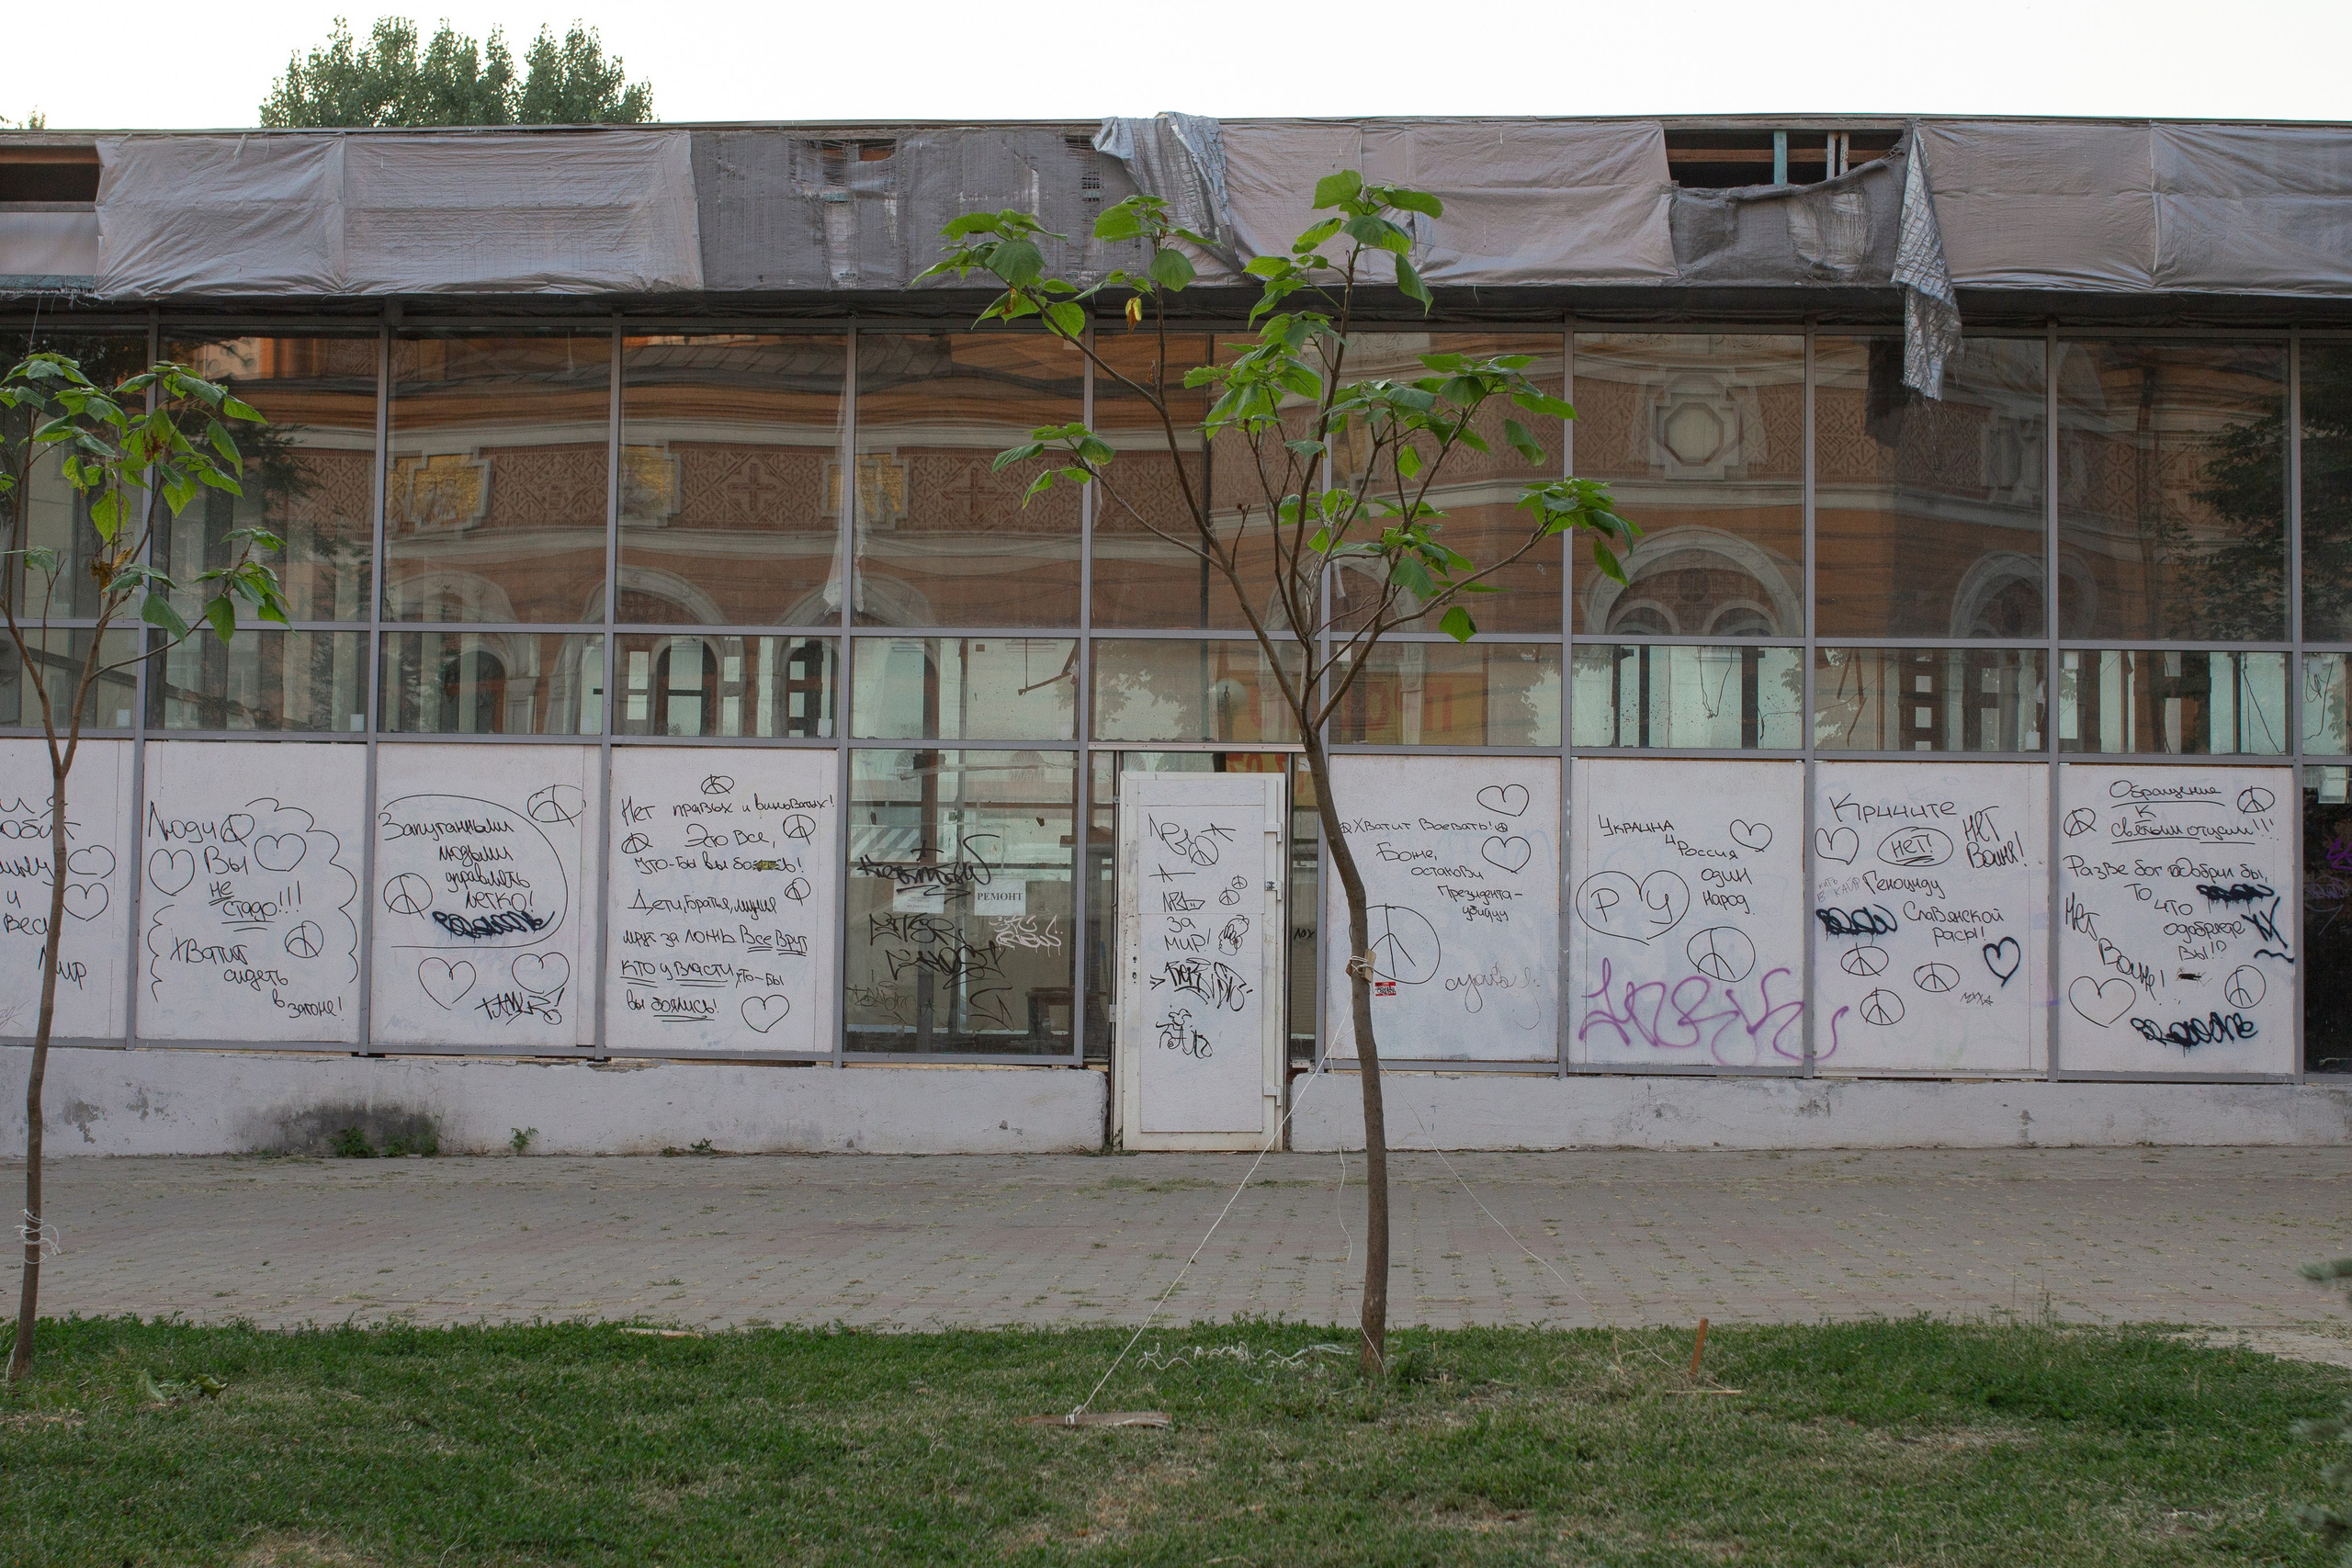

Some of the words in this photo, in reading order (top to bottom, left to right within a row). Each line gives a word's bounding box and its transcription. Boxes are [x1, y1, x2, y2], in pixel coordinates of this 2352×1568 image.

[2109, 780, 2222, 801] Обращение
[1828, 793, 1958, 823] Кричите
[148, 800, 217, 843] Люди
[1352, 817, 1411, 834] Хватит
[684, 823, 729, 848] Это
[2063, 854, 2130, 880] Разве
[977, 892, 1023, 901] РЕМОНТ
[1861, 870, 1946, 899] Геноциду
[1903, 900, 2005, 924] Славянской
